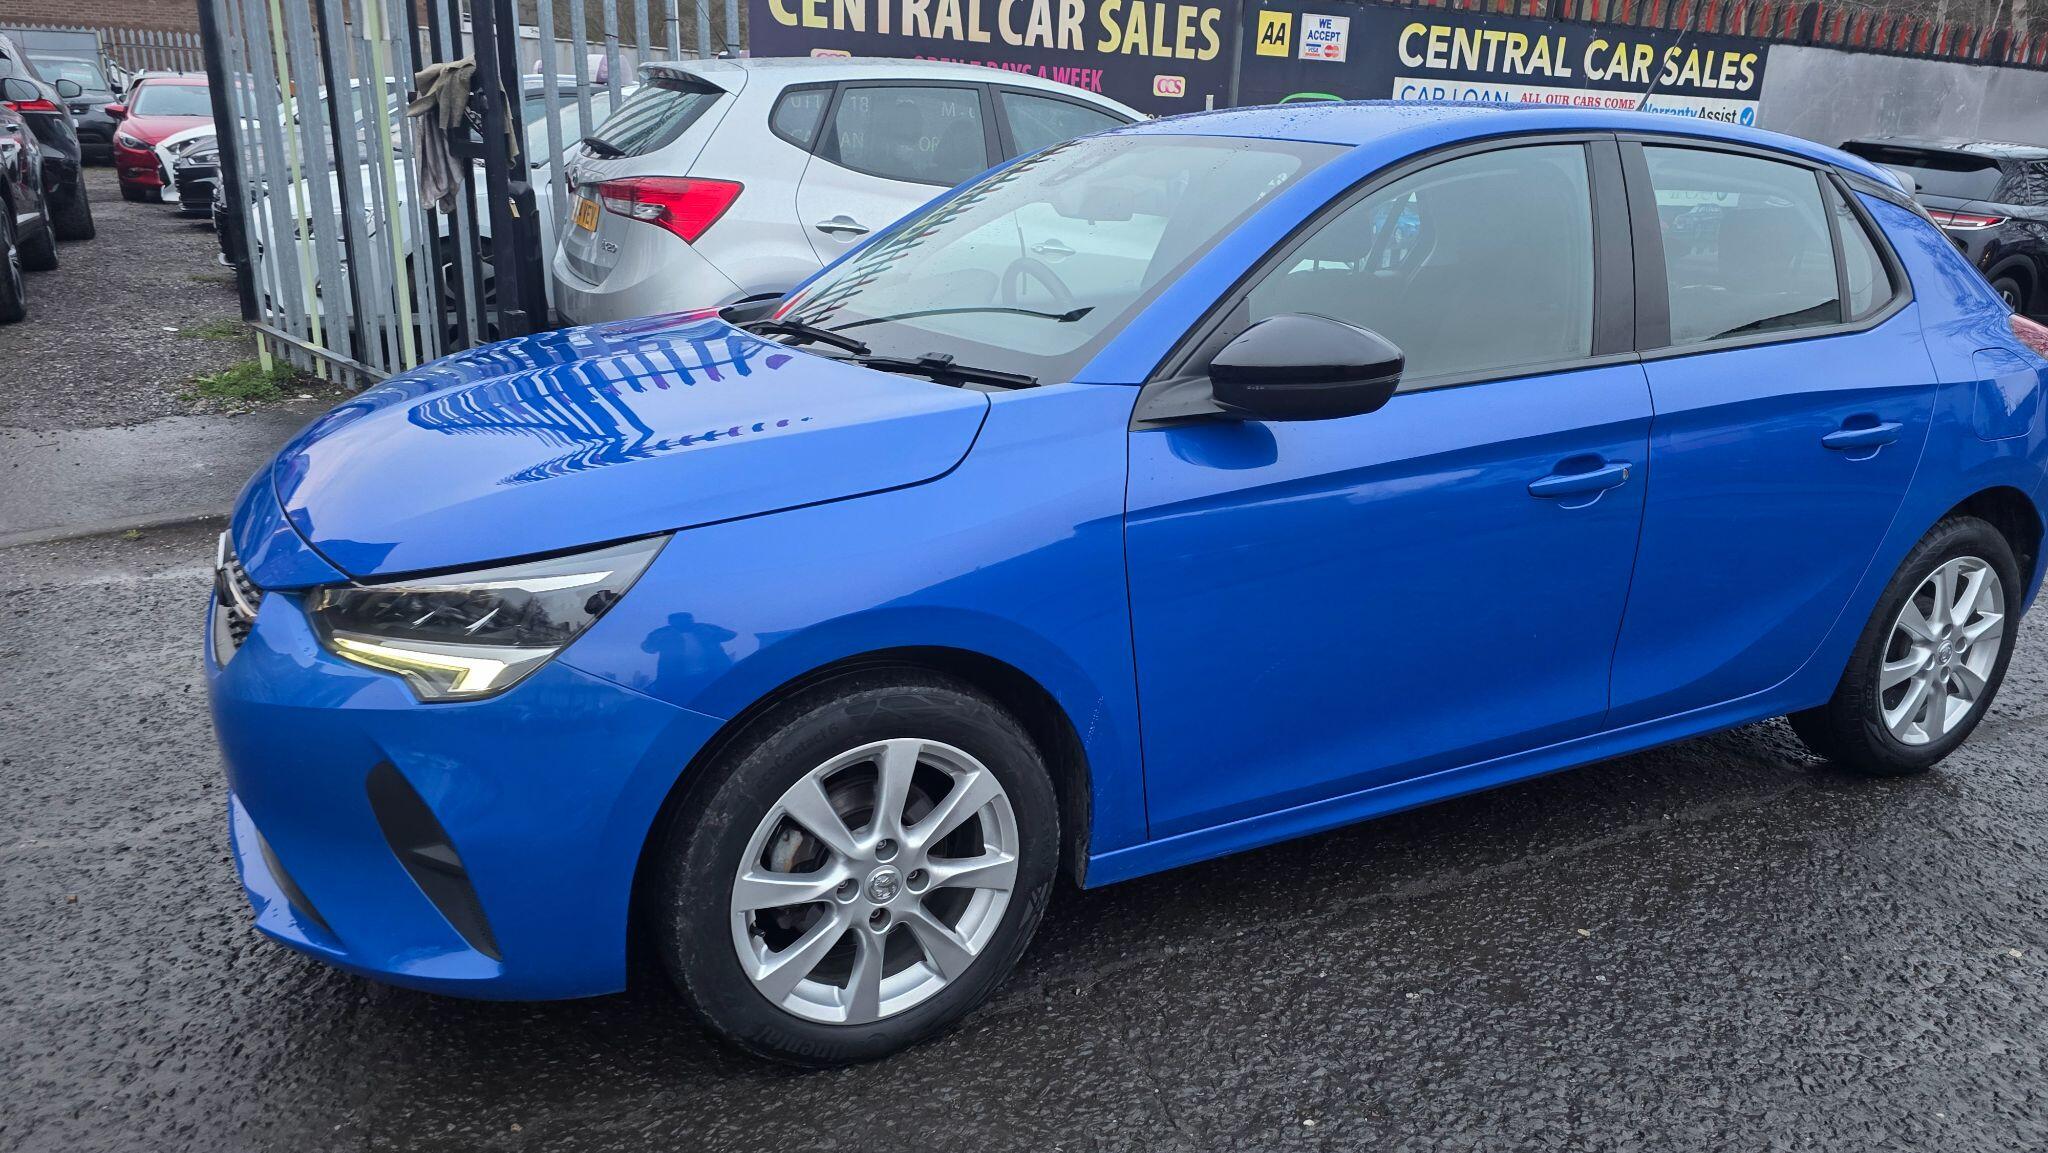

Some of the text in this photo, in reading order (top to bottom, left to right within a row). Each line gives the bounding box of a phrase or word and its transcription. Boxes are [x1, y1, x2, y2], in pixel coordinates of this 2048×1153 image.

[998, 0, 1085, 50] CAR
[1098, 0, 1222, 61] SALES
[1261, 21, 1286, 45] AA
[1319, 18, 1332, 29] WE
[1307, 30, 1341, 42] ACCEPT
[1398, 22, 1758, 92] CENTRAL CAR SALES
[1052, 66, 1104, 93] WEEK
[1157, 78, 1182, 94] CCS
[1520, 93, 1636, 109] ALL OUR CARS COME
